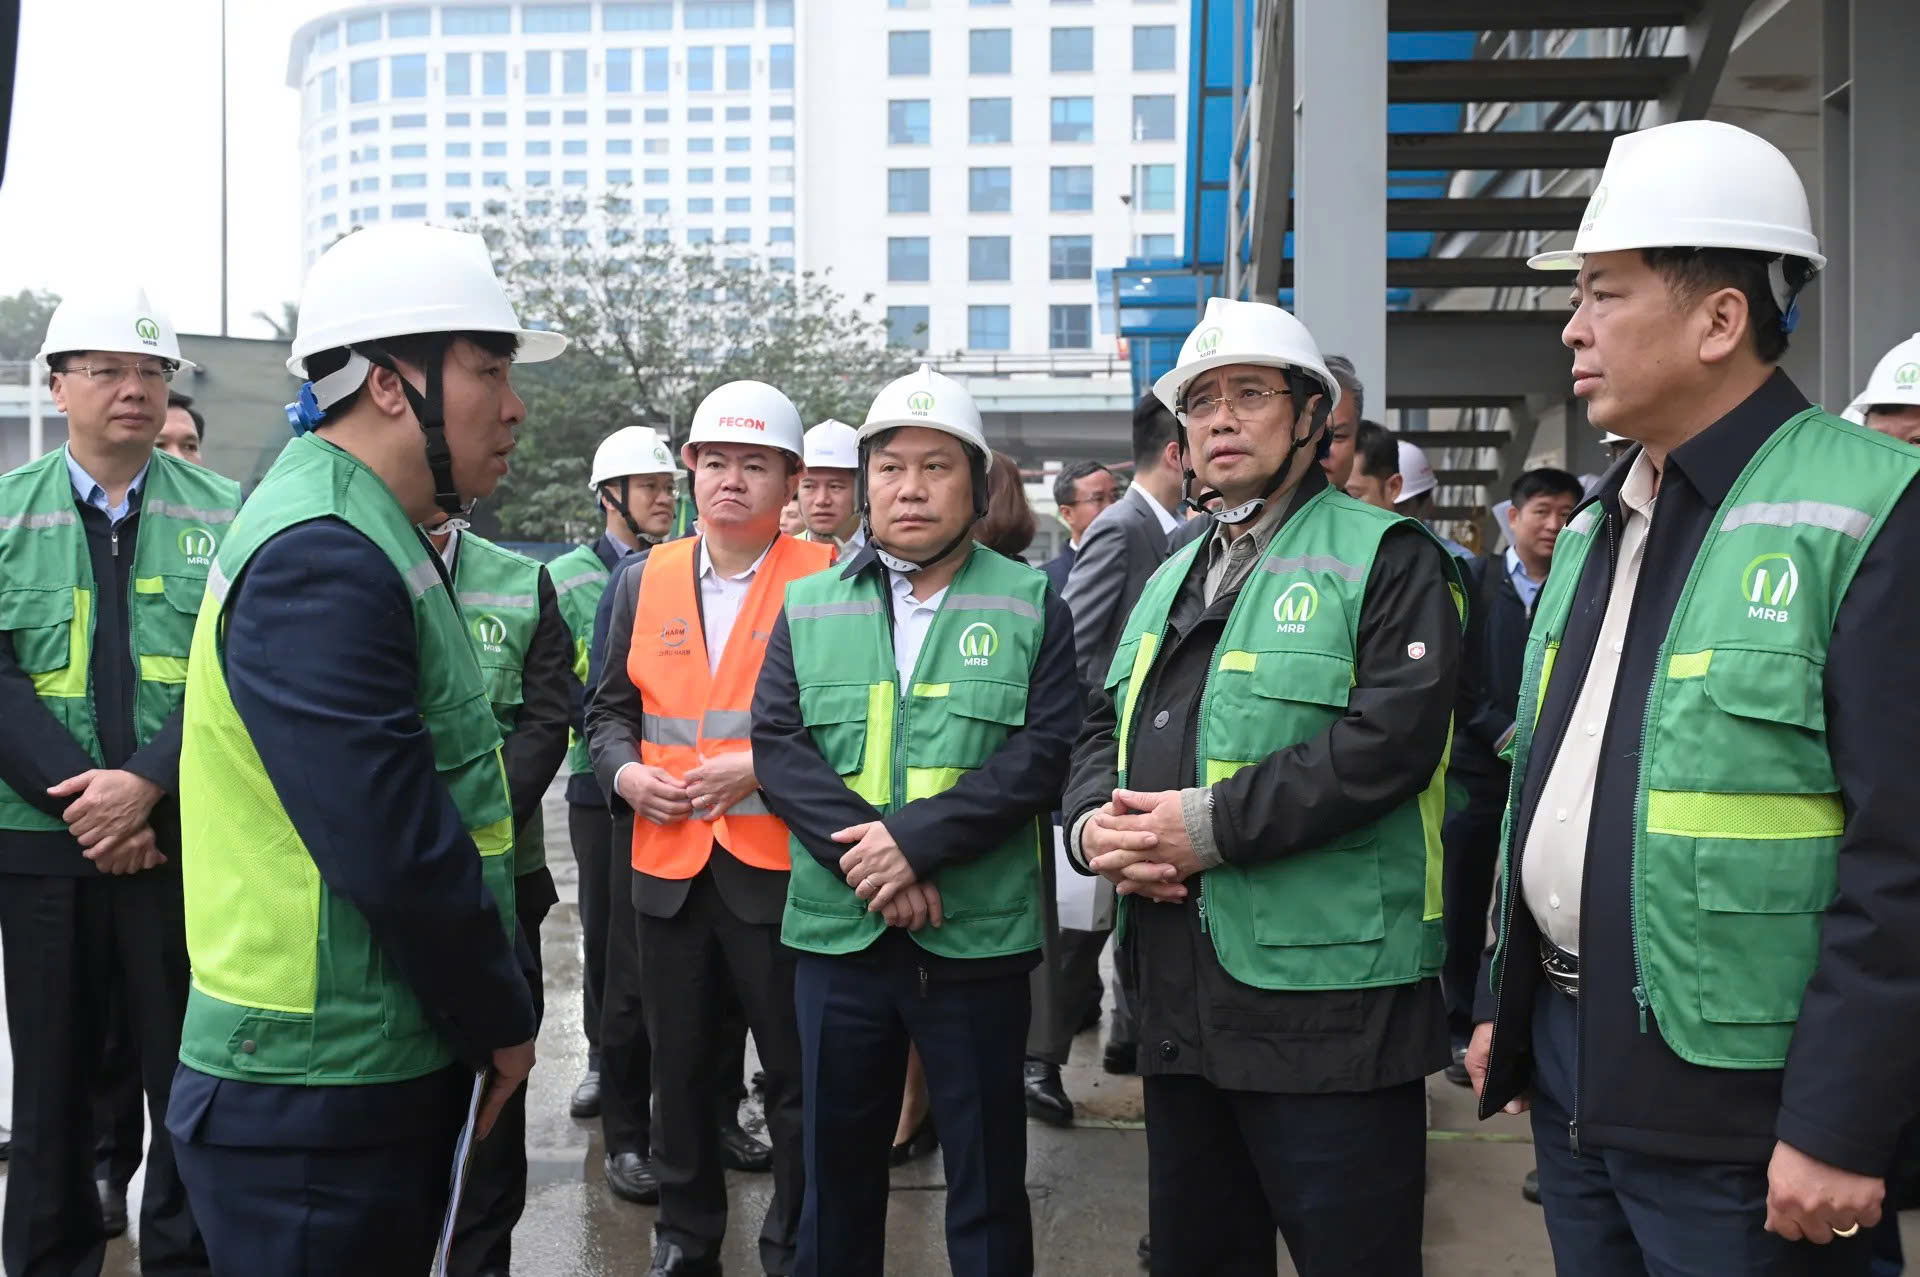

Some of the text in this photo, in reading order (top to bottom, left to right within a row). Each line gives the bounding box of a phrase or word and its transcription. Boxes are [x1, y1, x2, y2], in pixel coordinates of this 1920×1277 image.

[719, 416, 766, 431] FECON
[187, 556, 209, 565] MRB
[1748, 605, 1788, 622] MRB
[1276, 623, 1306, 633] MRB
[483, 643, 502, 653] MRB
[963, 657, 989, 667] MRB
